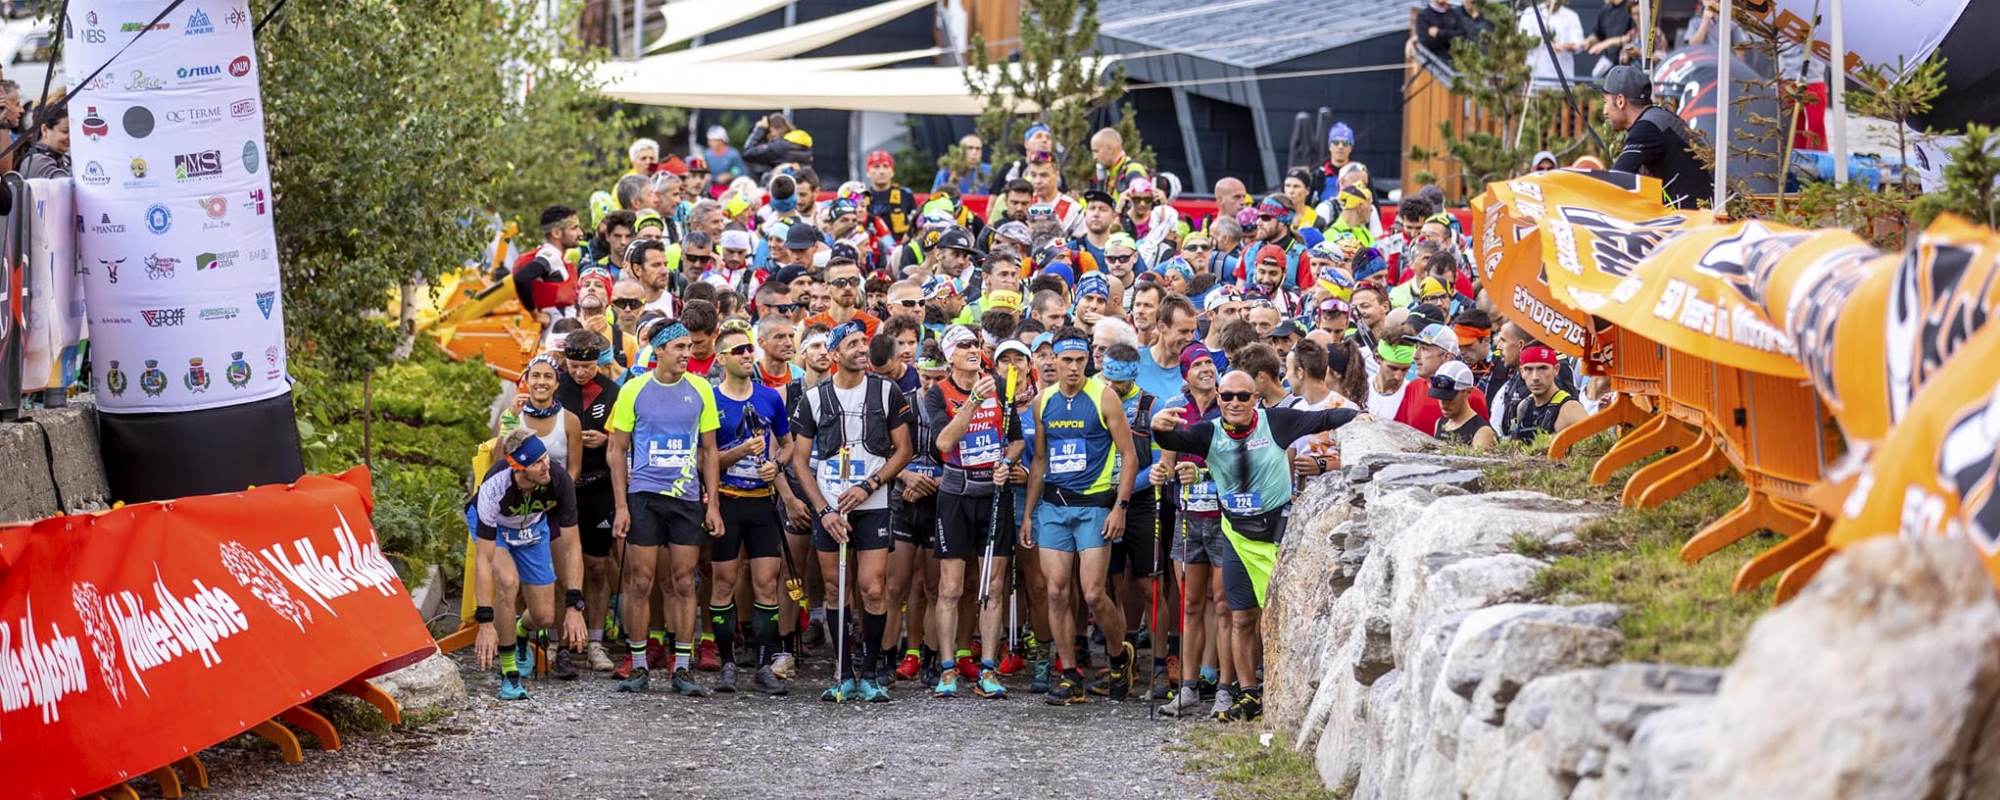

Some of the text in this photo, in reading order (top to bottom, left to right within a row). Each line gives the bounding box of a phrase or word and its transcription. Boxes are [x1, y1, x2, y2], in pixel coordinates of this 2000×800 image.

[80, 29, 106, 44] NBS
[189, 64, 221, 77] STELLA
[187, 106, 222, 119] TERME
[976, 434, 991, 448] 474
[1235, 497, 1252, 508] 224
